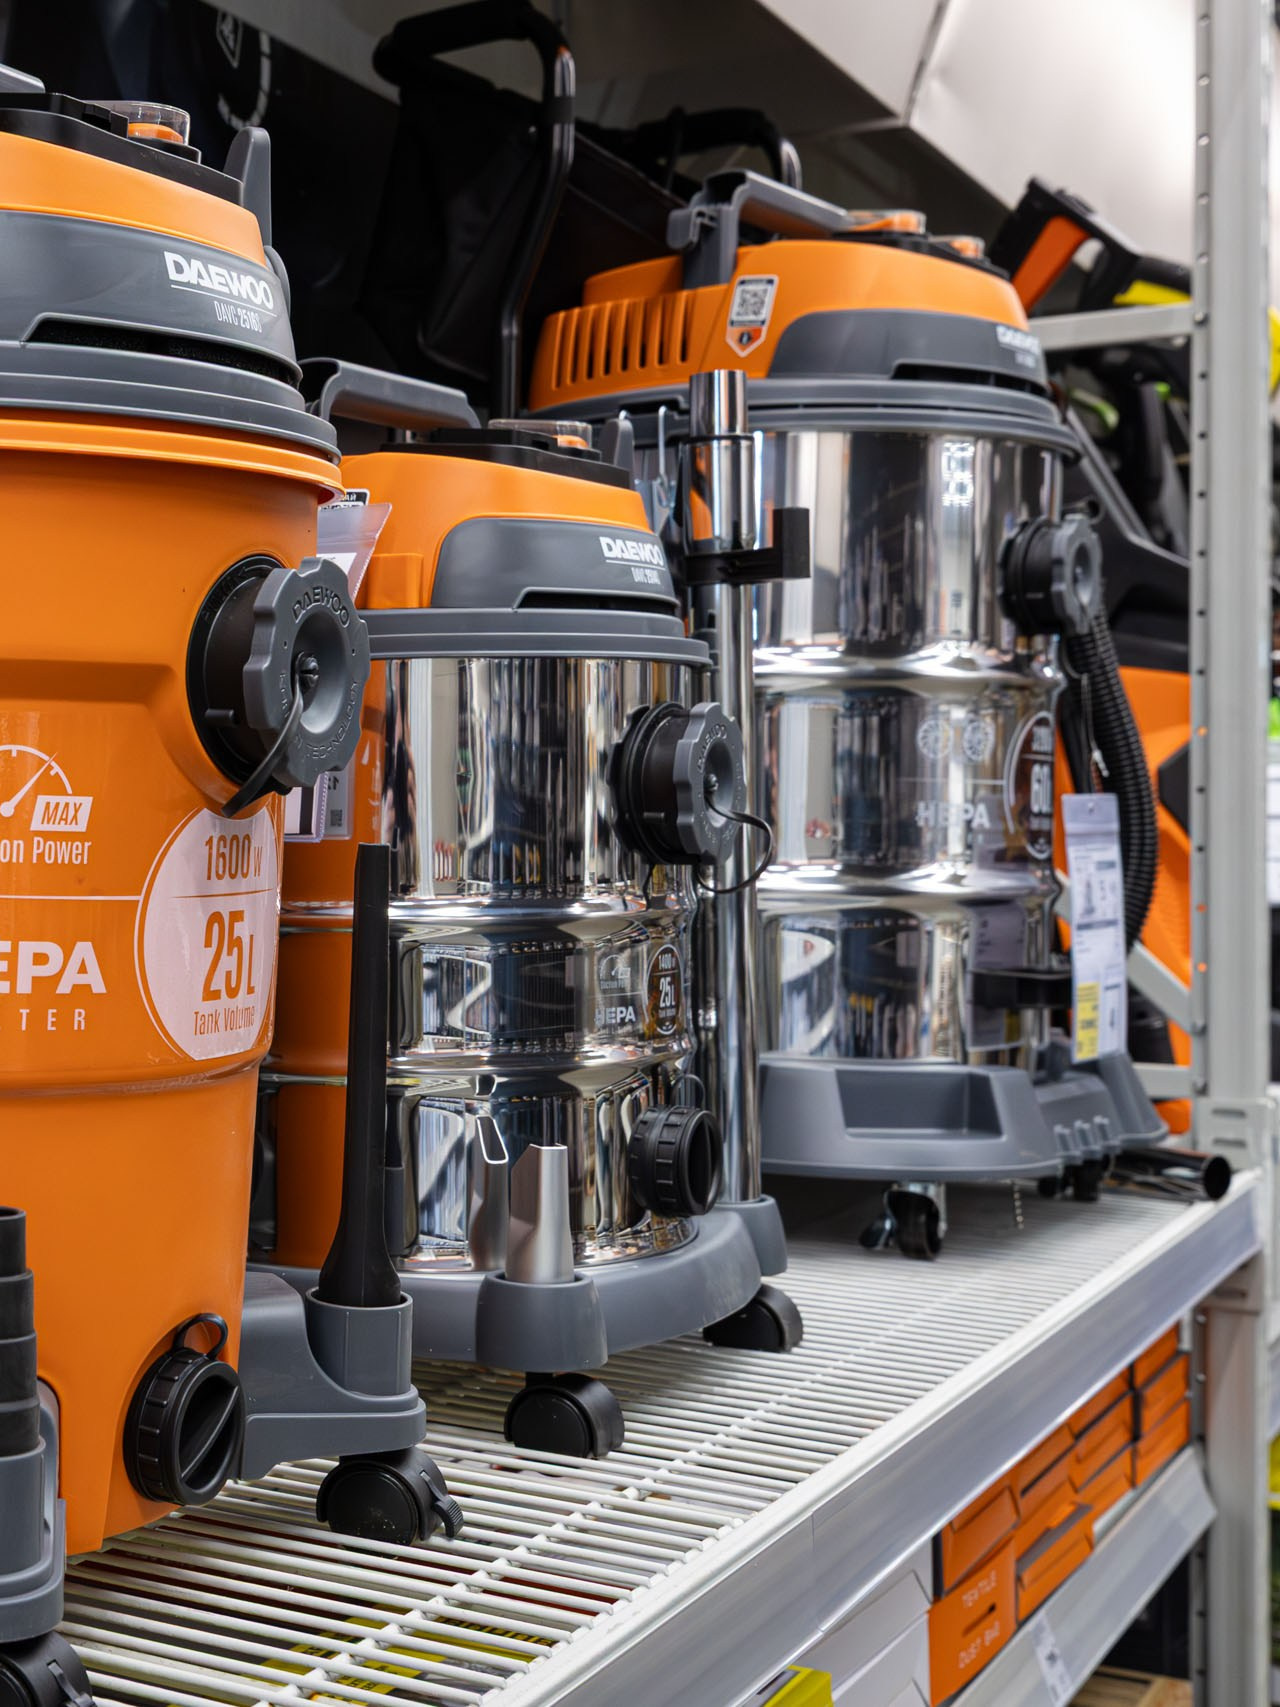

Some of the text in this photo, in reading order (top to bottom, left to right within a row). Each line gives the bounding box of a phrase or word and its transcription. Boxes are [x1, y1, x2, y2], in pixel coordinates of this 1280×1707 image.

[164, 251, 274, 310] DAEWOO
[214, 300, 238, 326] DAVC
[599, 536, 664, 566] DAEWOO
[292, 585, 350, 628] DAEWOO
[41, 801, 83, 826] MAX
[32, 836, 92, 865] Power
[194, 1005, 255, 1036] Tank Volume
[594, 1006, 636, 1027] HEPA
